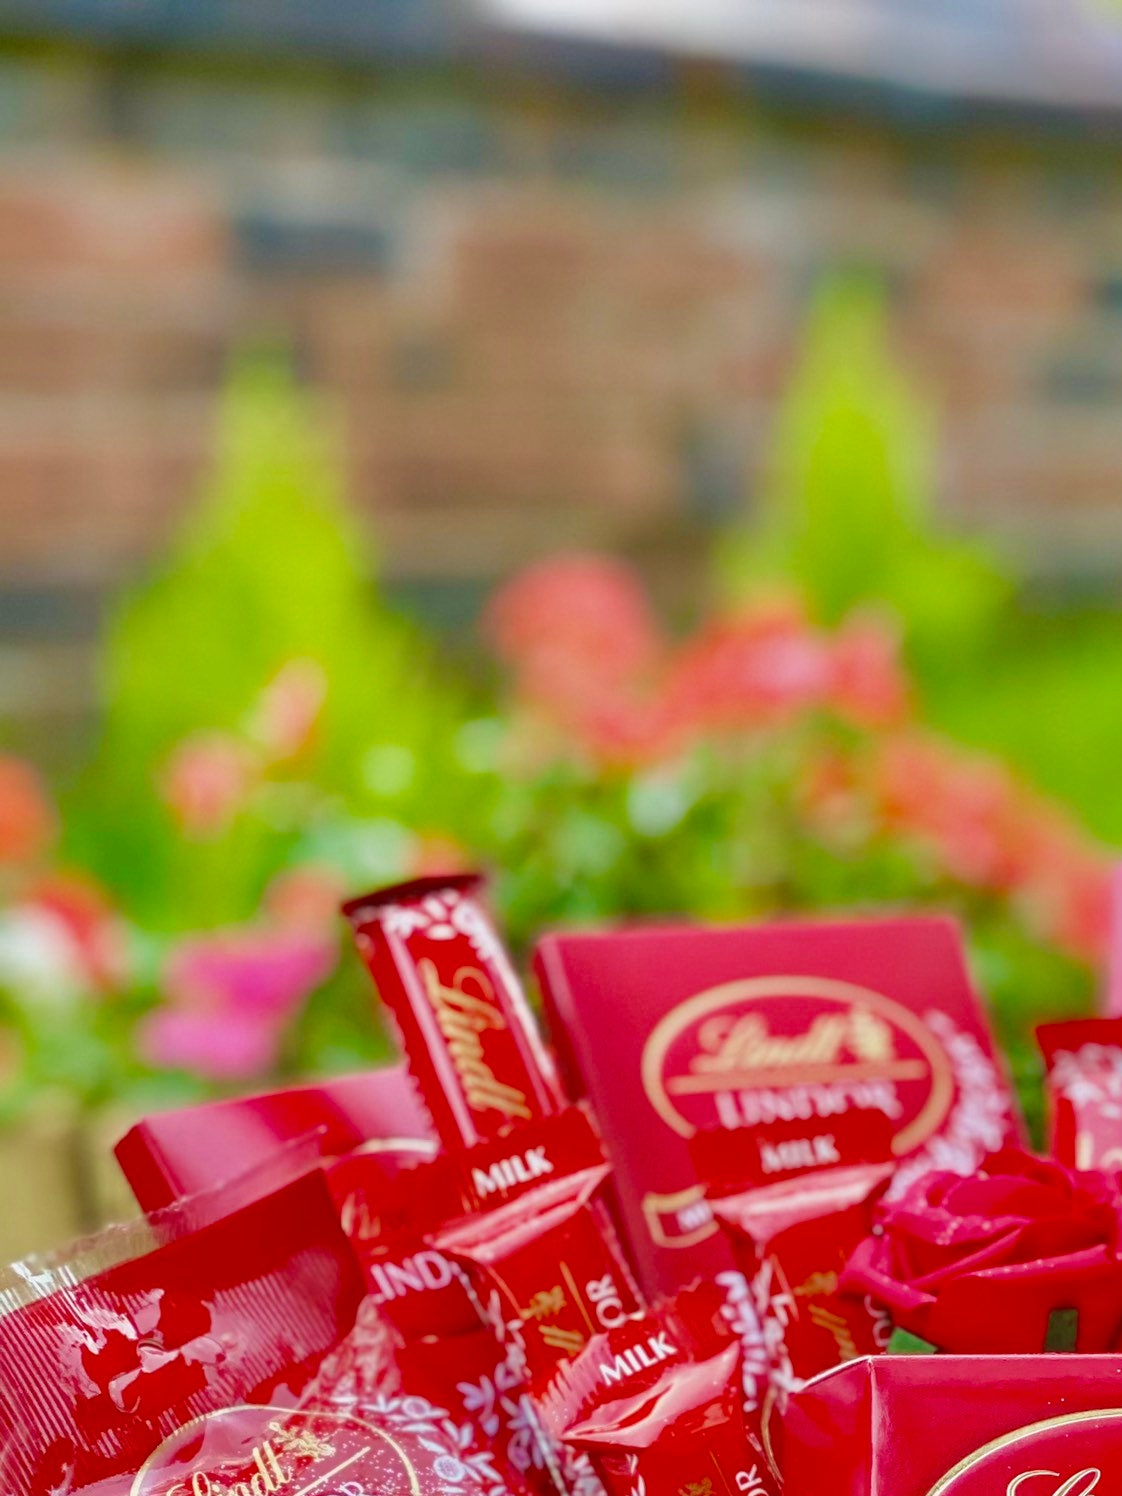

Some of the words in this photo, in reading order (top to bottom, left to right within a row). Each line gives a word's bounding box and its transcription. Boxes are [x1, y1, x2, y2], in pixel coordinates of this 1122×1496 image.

[472, 1146, 553, 1197] MILK
[368, 1250, 452, 1301] IND
[600, 1332, 677, 1387] MILK
